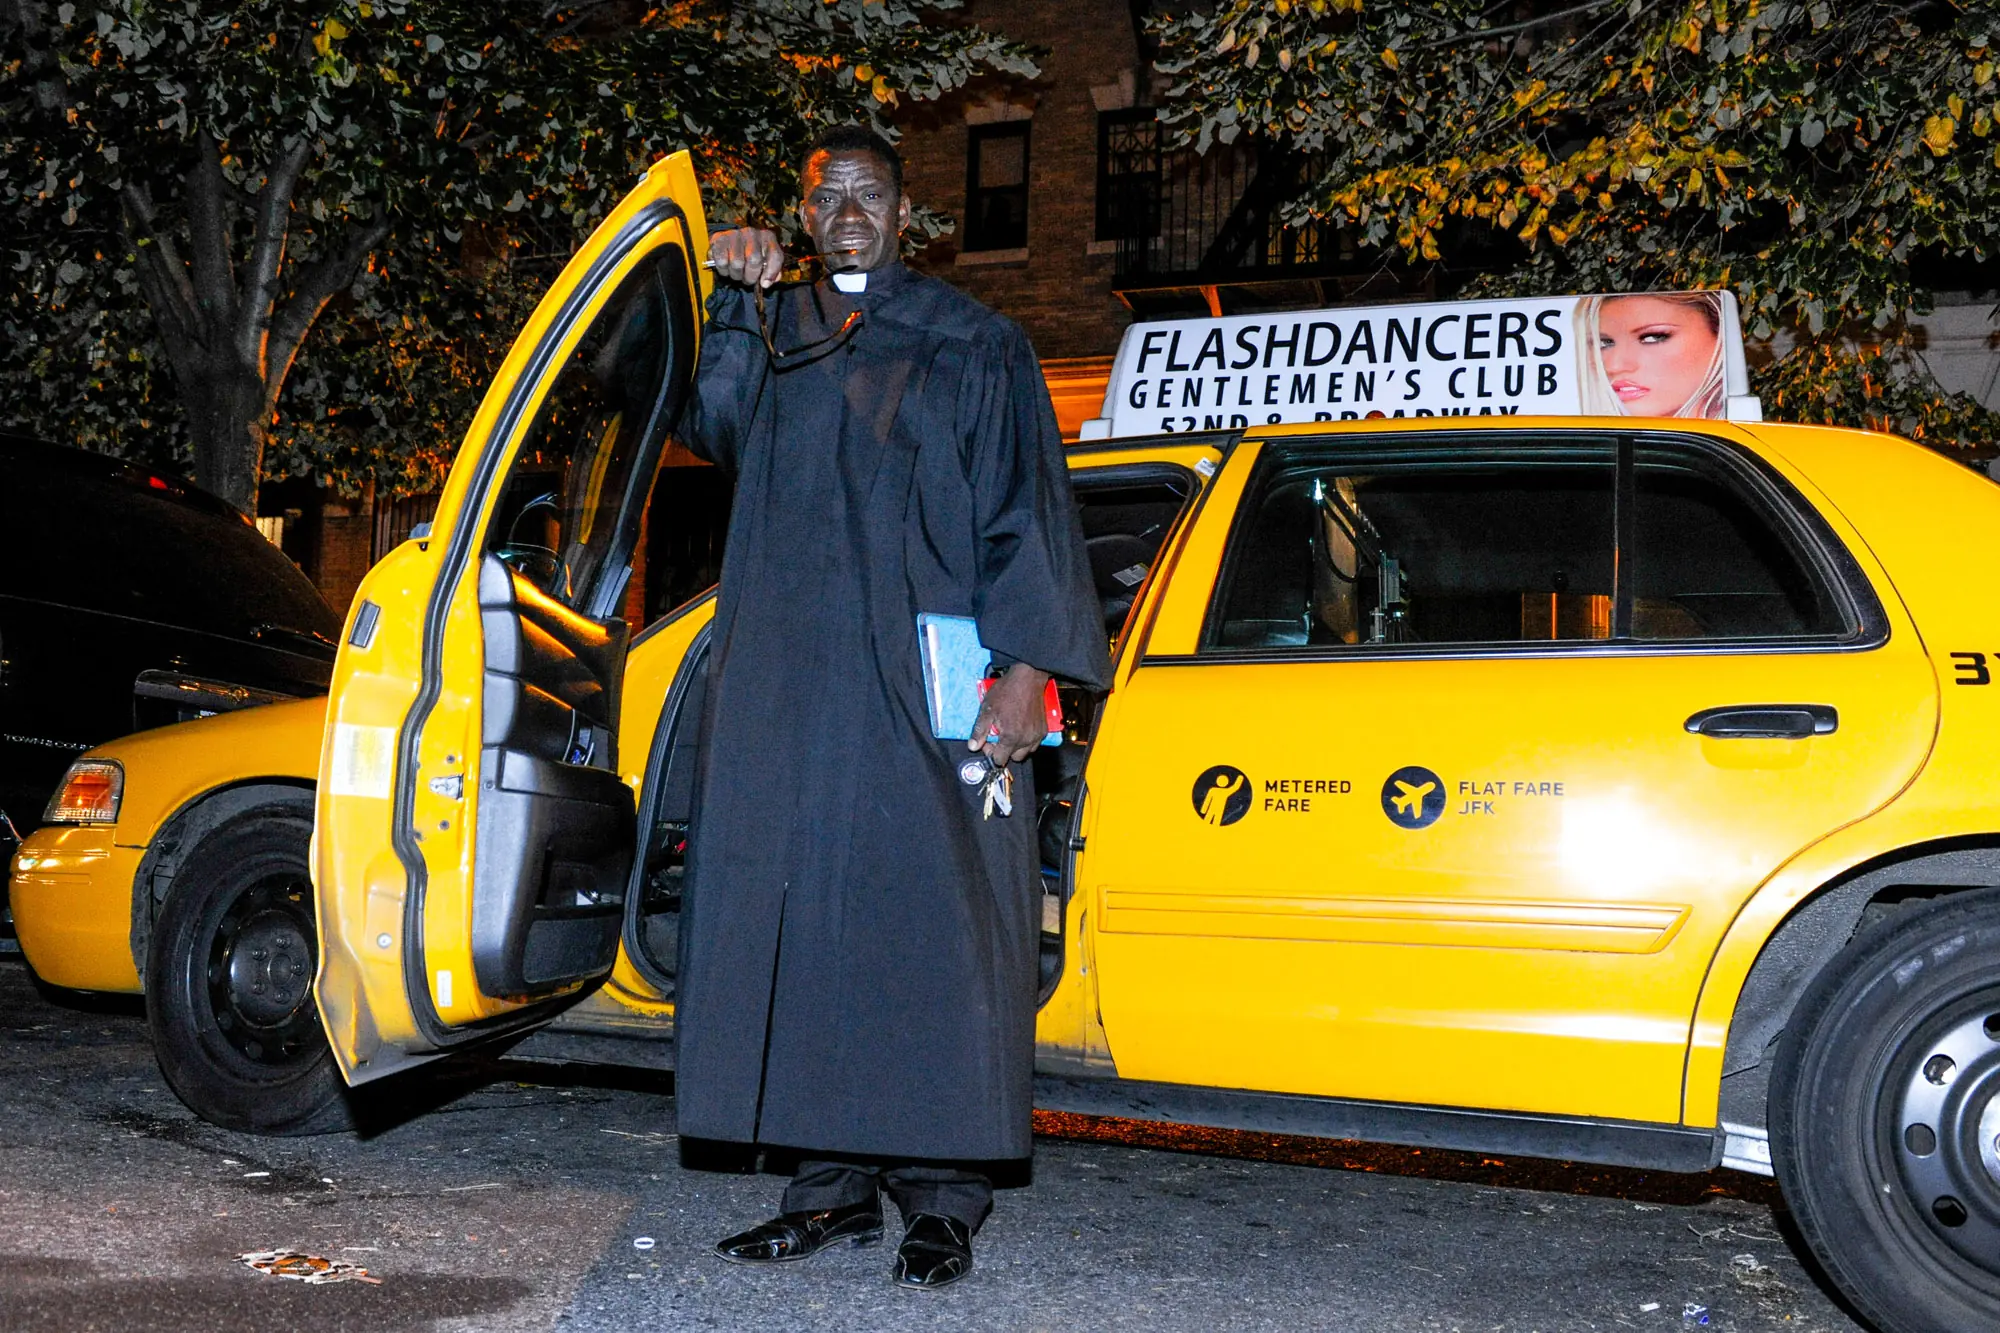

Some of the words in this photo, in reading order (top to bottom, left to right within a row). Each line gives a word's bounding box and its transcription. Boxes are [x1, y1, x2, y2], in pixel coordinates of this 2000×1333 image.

[1137, 309, 1562, 373] FLASHDANCERS
[1129, 368, 1422, 409] GENTLEMEN'S
[1448, 363, 1558, 399] CLUB
[1949, 651, 2000, 686] 3
[1264, 780, 1352, 794] METERED
[1458, 781, 1506, 796] FLAT
[1513, 782, 1565, 796] FARE
[1264, 798, 1311, 812] FARE
[1458, 801, 1495, 815] JFK
